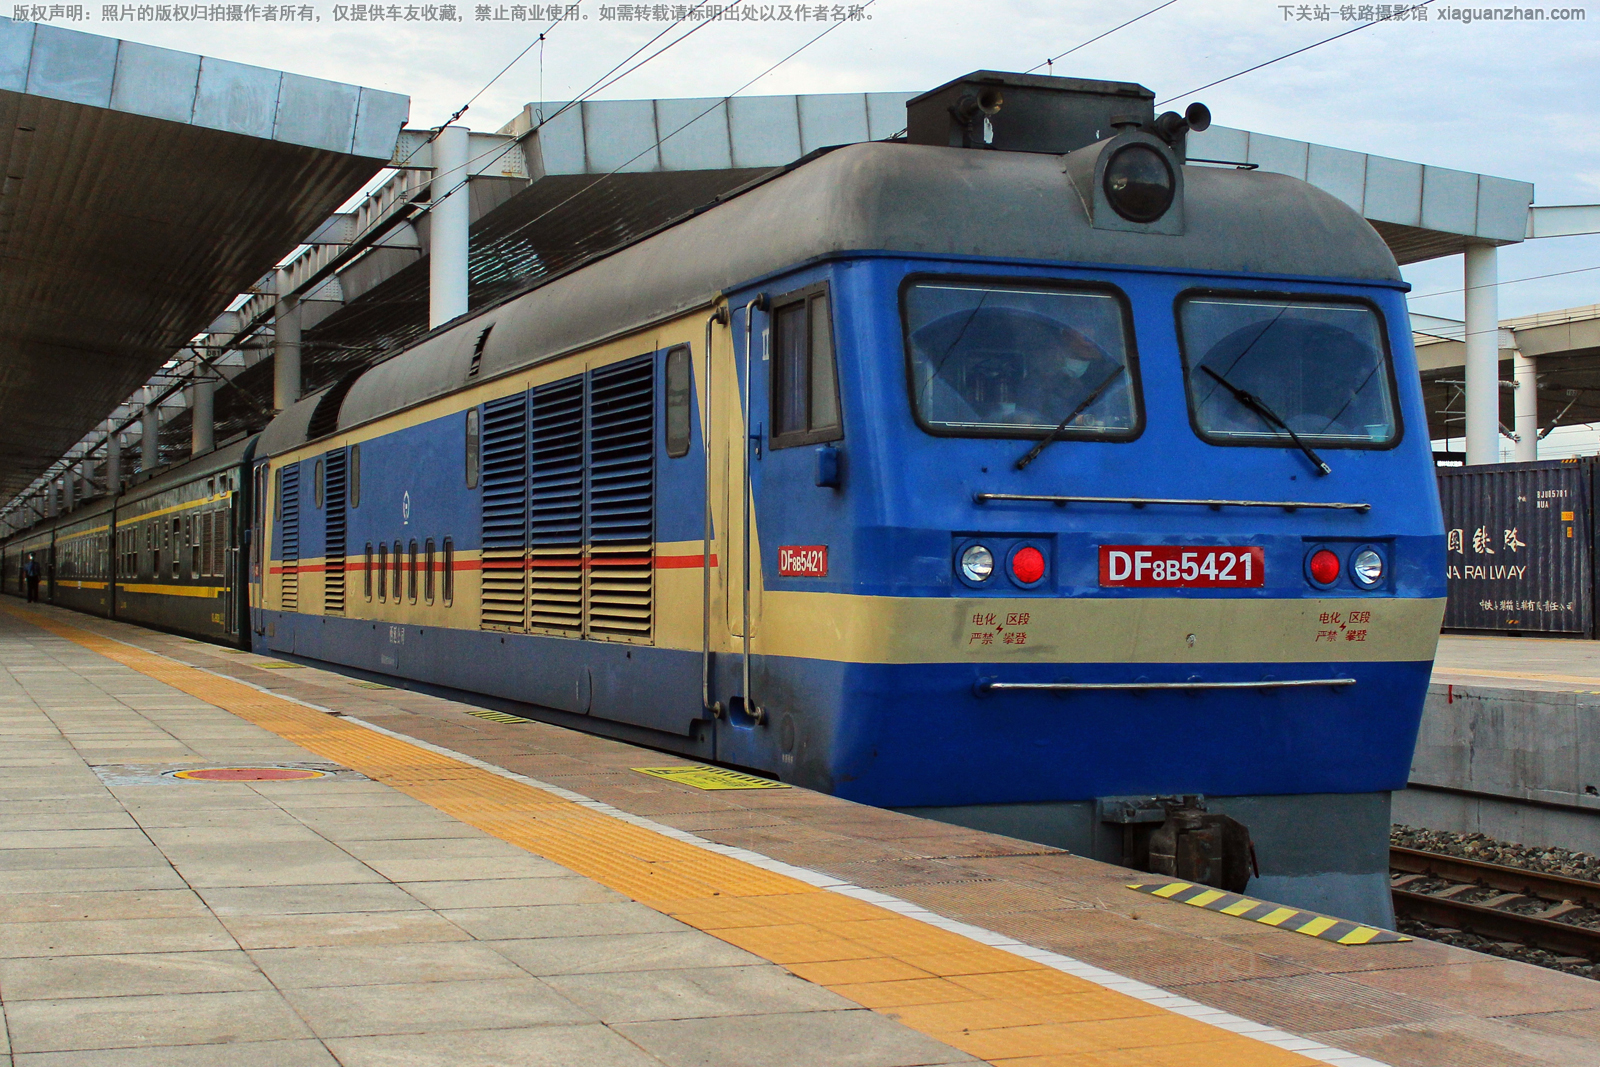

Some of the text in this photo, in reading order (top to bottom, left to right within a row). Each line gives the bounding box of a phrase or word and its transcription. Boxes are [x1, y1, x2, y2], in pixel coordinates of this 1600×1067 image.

[781, 550, 823, 572] DF8B5421
[1109, 551, 1252, 581] DF8B5421
[1464, 565, 1527, 580] RAILWAY
[972, 612, 1030, 626] 电化 区段
[1319, 611, 1371, 625] 电化 区段
[968, 631, 1027, 646] 严禁 攀登
[1315, 629, 1367, 643] 严禁 攀登
